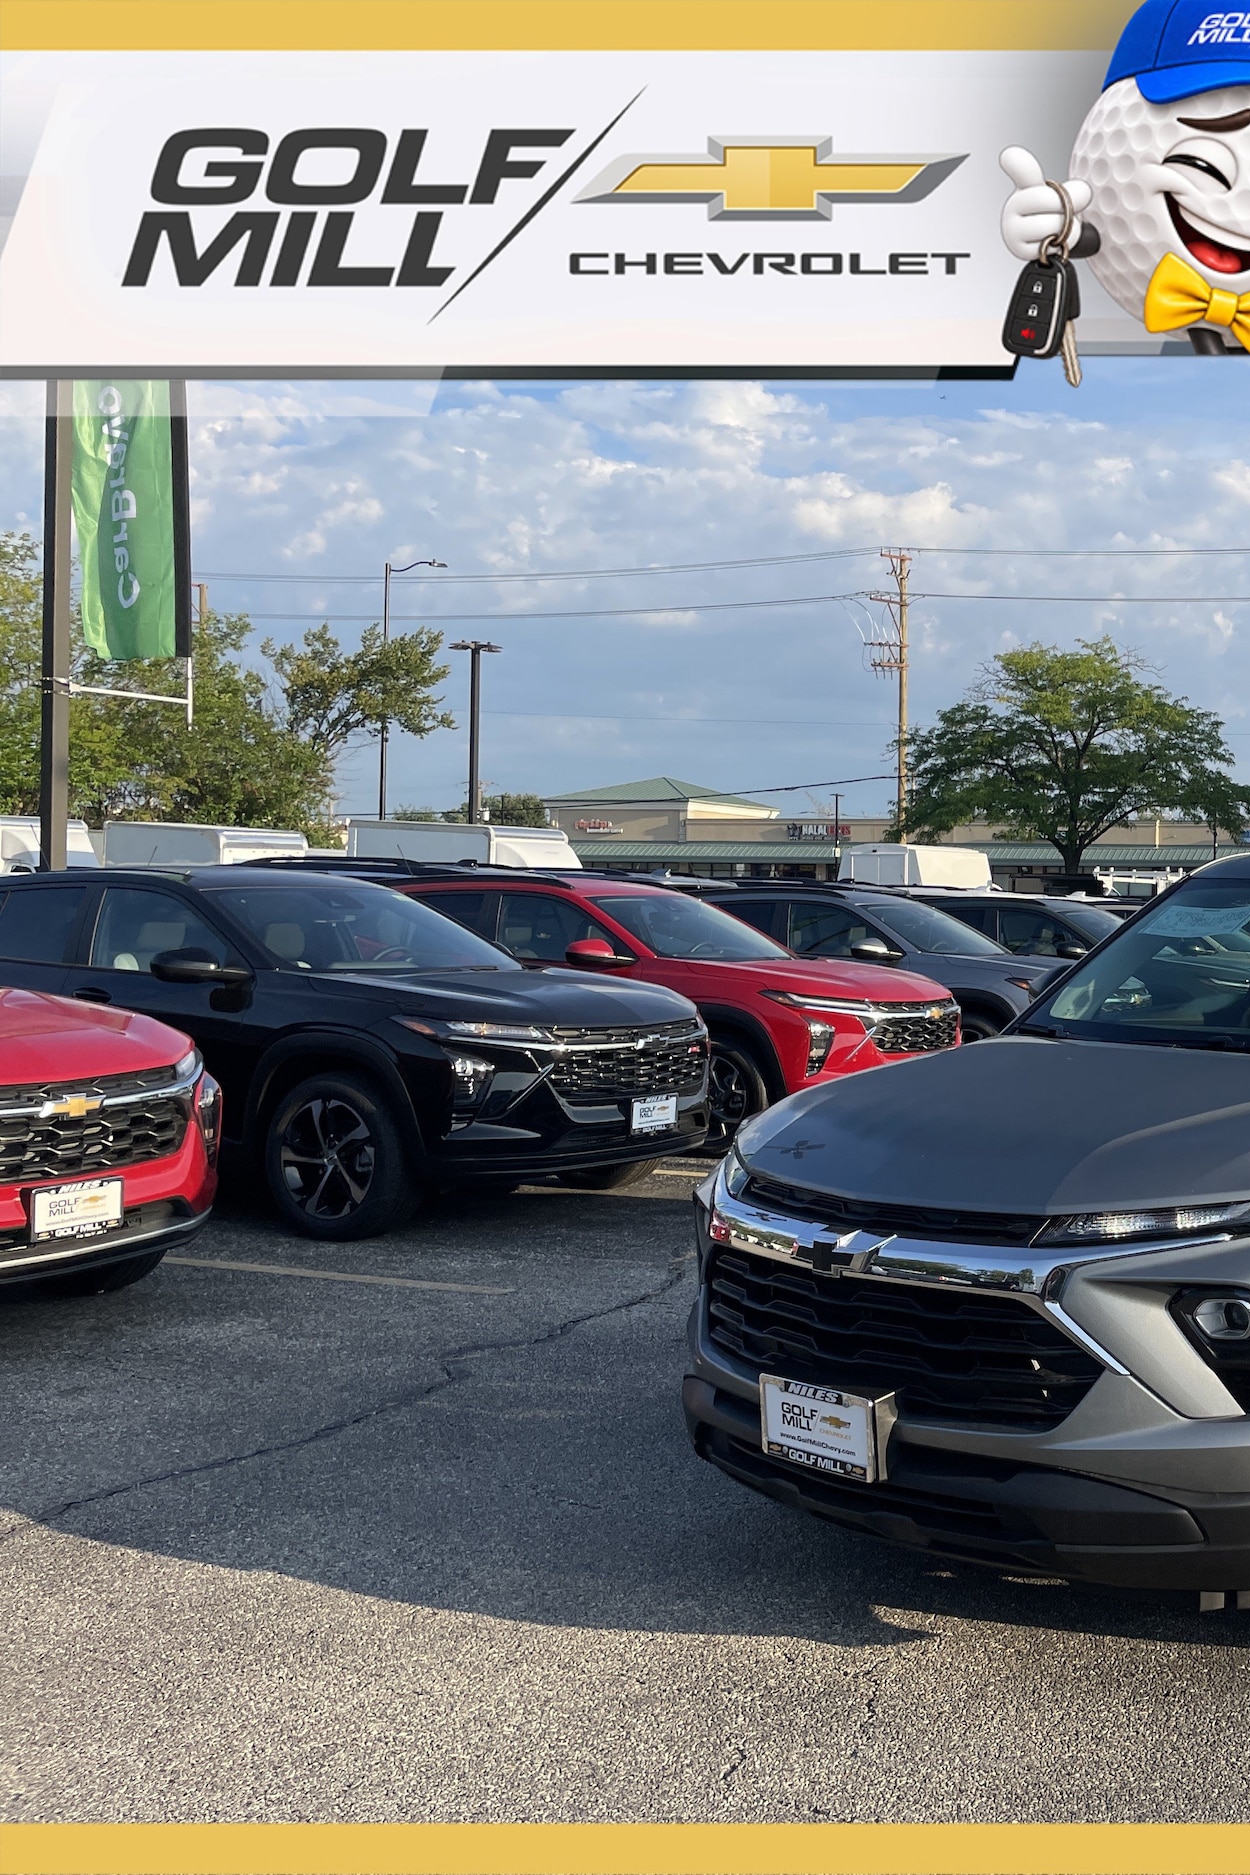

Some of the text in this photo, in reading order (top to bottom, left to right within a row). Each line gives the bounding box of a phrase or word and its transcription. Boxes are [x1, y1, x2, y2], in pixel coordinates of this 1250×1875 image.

[802, 824, 828, 836] HALAL
[58, 1180, 102, 1194] NILES
[49, 1197, 82, 1209] GOLF
[48, 1208, 75, 1218] MILL
[787, 1382, 838, 1403] NILES
[781, 1401, 819, 1420] GOLF
[782, 1413, 813, 1432] MILL
[780, 1431, 856, 1457] www.GolfMillChevy.com
[788, 1449, 845, 1474] GOLF MILL
